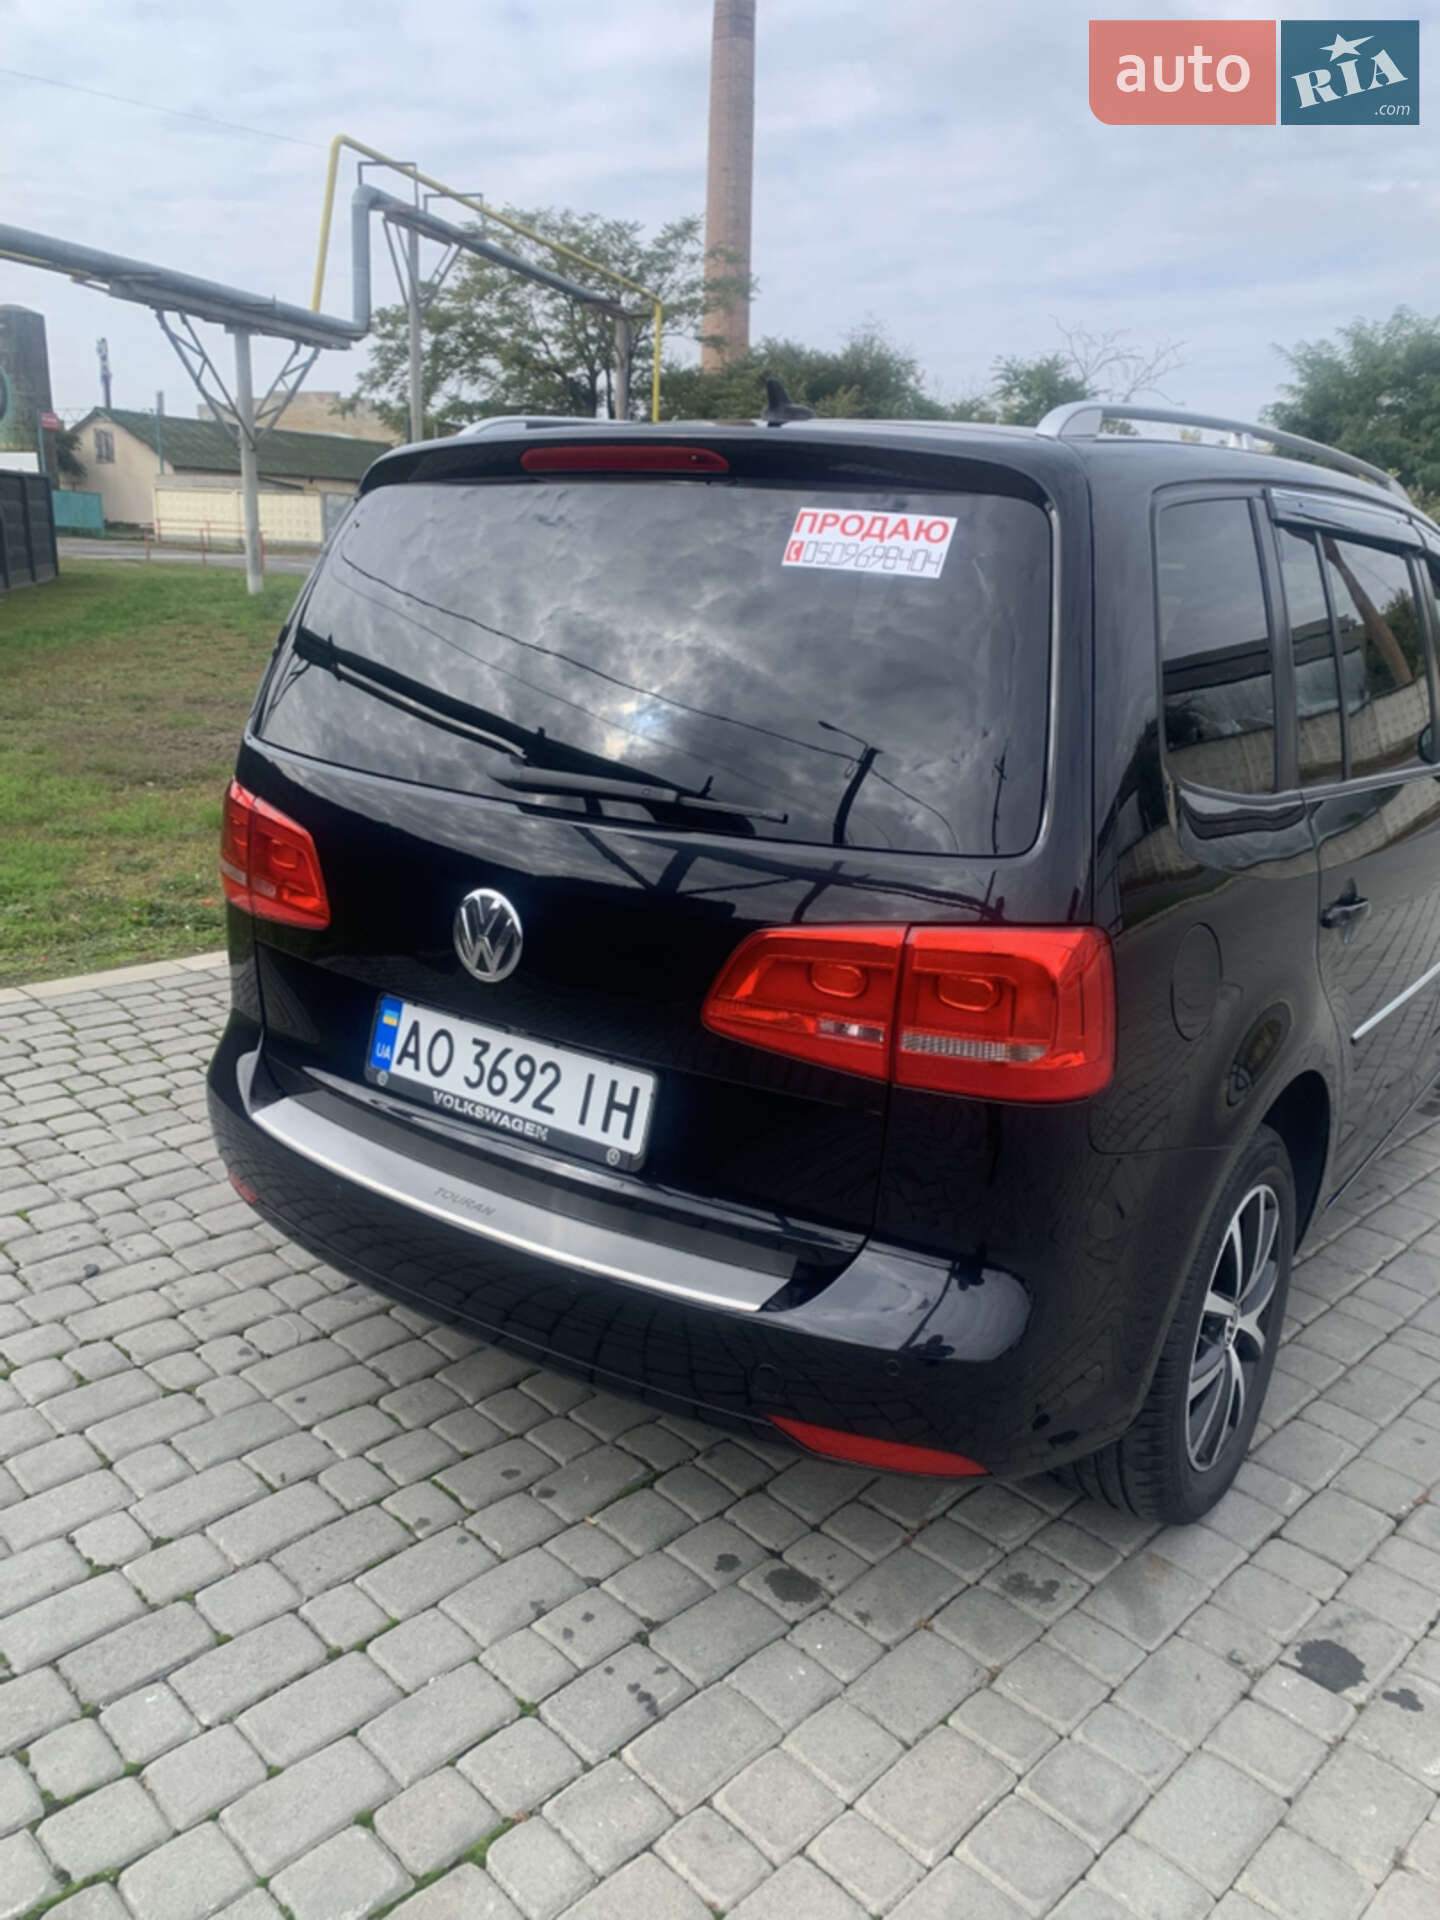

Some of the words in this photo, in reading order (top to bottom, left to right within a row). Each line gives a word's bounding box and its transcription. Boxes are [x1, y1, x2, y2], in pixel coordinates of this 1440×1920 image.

[794, 511, 950, 544] ПРОДАЮ
[801, 540, 944, 574] 0509698404
[376, 1041, 392, 1061] UA
[396, 1019, 454, 1078] AO
[463, 1036, 562, 1116] 3692
[578, 1072, 640, 1141] IH
[432, 1089, 549, 1142] VOLKSWAGEN
[433, 1186, 497, 1217] TOURAN
